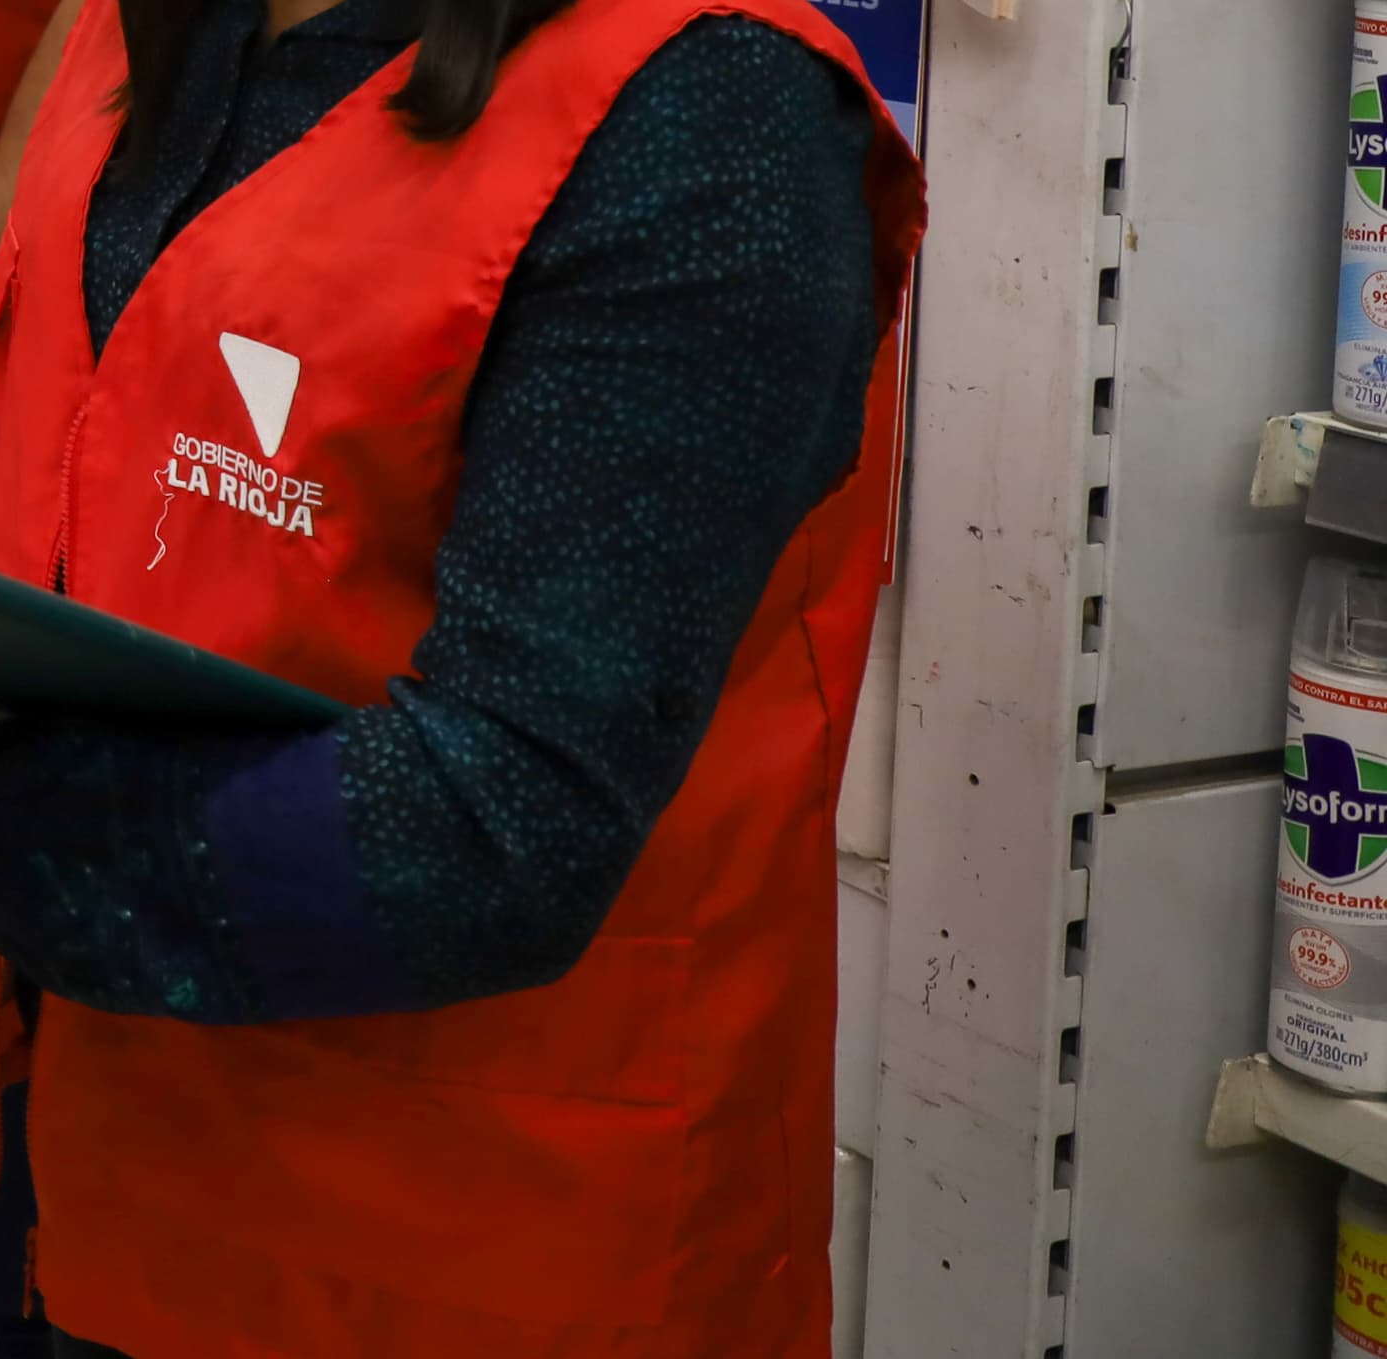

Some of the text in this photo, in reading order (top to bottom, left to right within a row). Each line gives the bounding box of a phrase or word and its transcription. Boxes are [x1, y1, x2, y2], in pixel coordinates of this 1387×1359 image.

[173, 432, 324, 506] GOBIERNO DE
[167, 458, 314, 537] LA RIOJA
[1304, 682, 1346, 704] CONTRA
[1349, 696, 1365, 708] EL
[1316, 1005, 1354, 1023] OLORES
[1286, 1015, 1348, 1043] ORIGINAL
